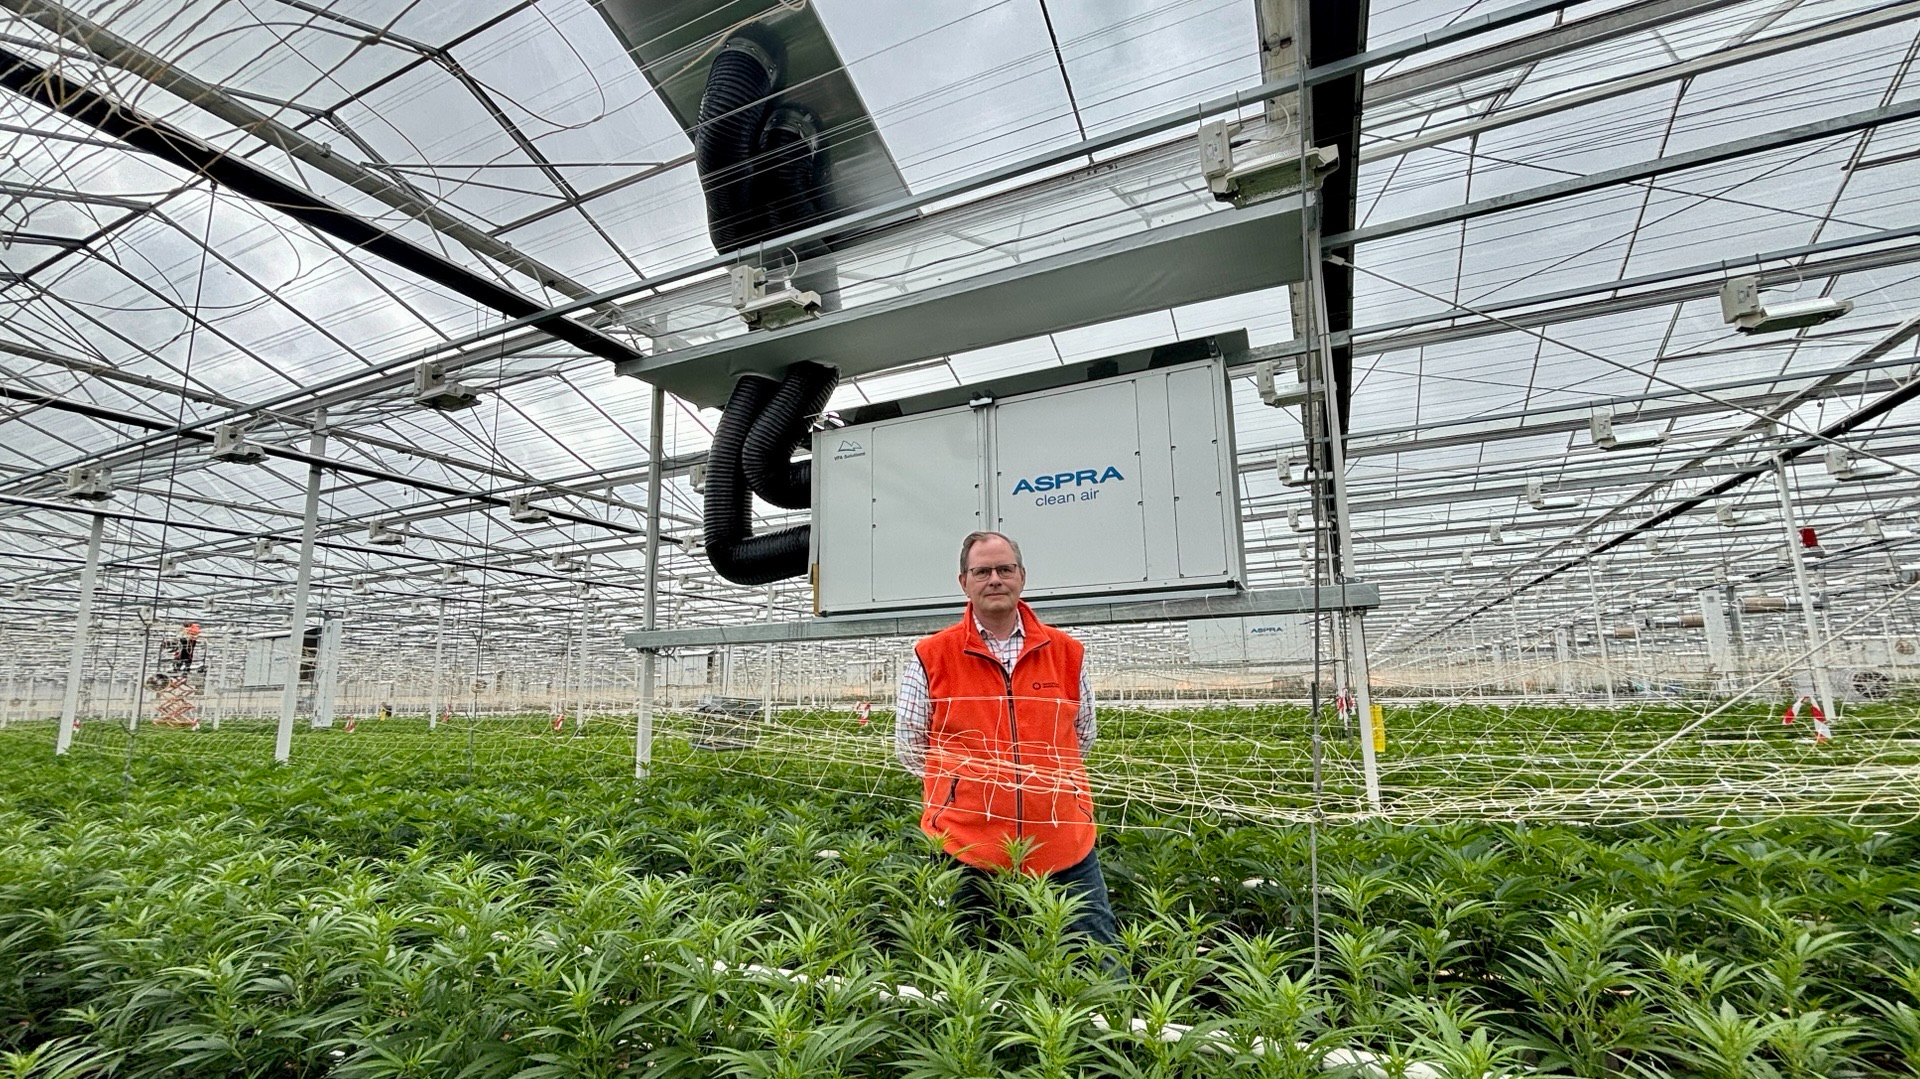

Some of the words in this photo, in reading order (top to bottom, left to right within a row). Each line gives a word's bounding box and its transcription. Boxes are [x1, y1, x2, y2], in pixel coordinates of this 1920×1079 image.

[1012, 466, 1124, 495] ASPRA
[1035, 493, 1075, 507] clean
[1080, 488, 1100, 501] air
